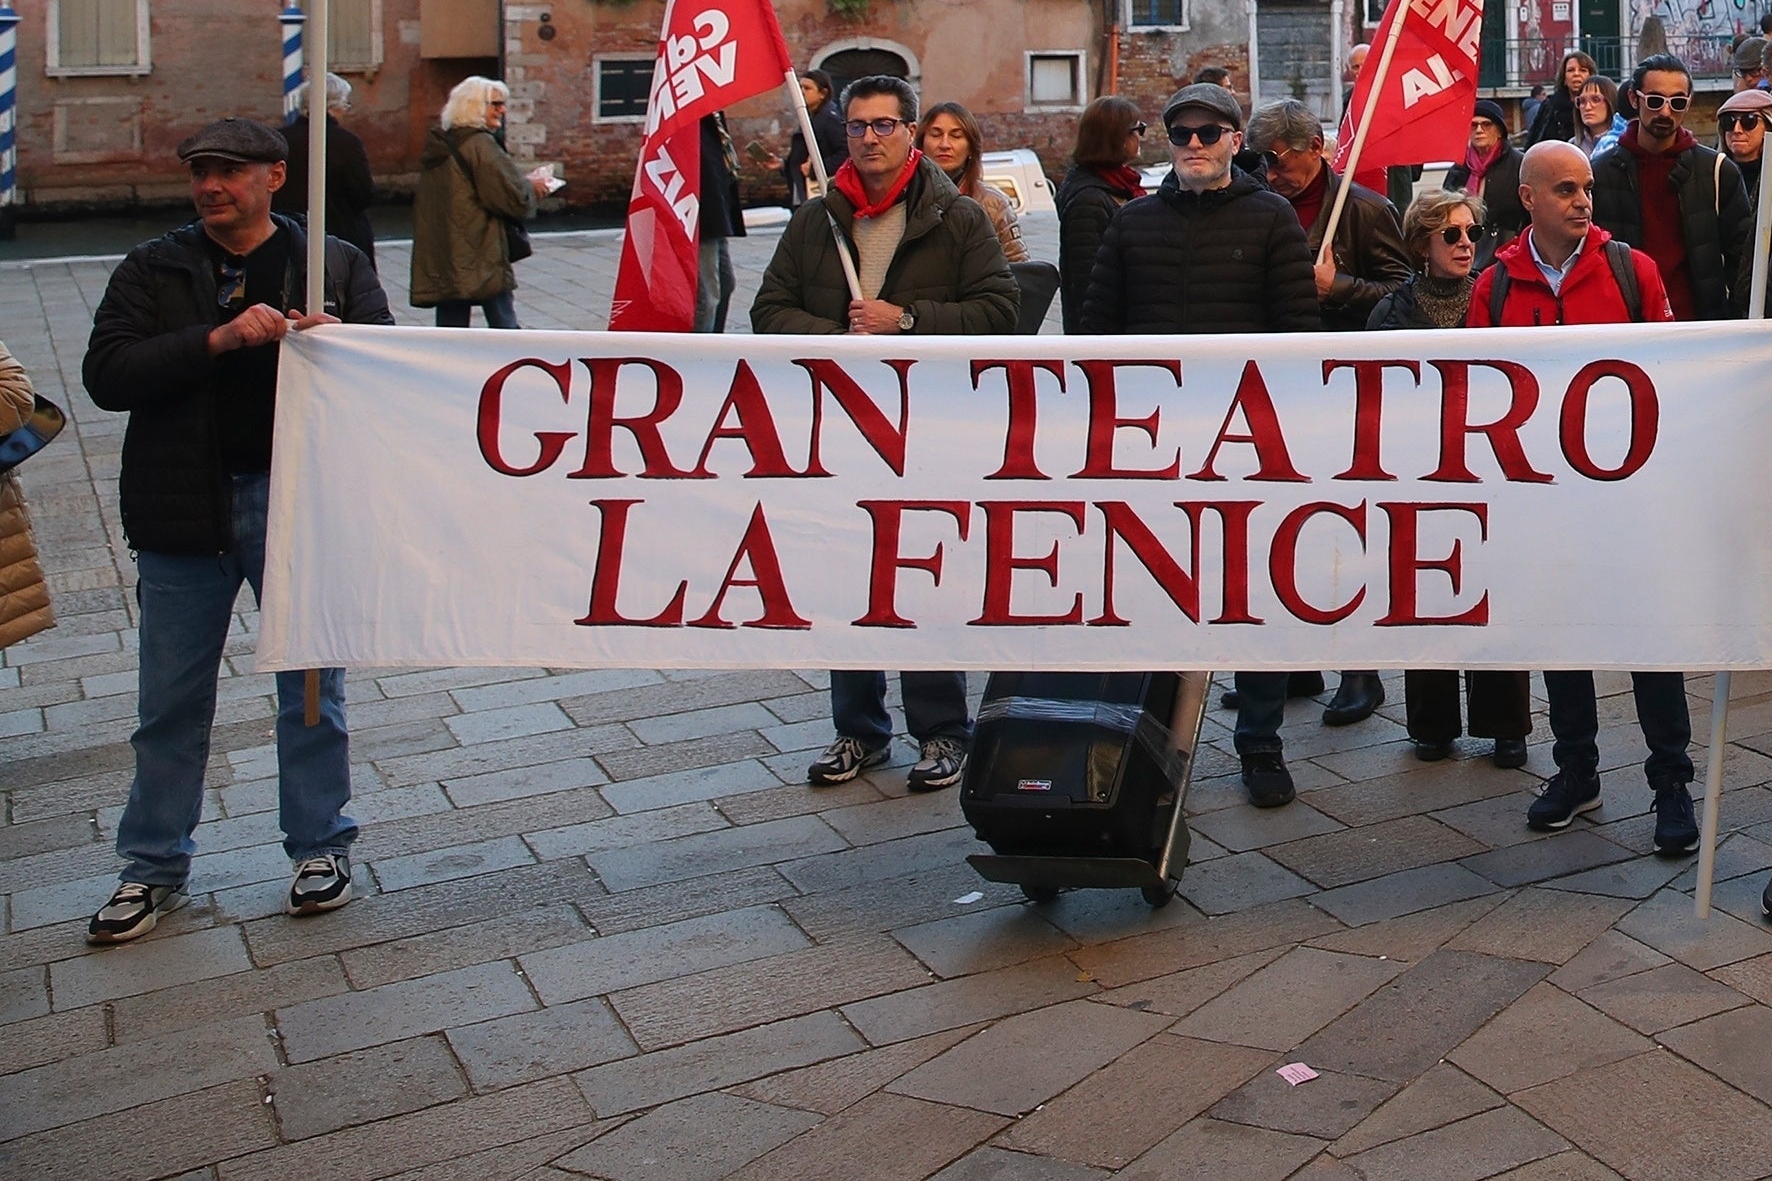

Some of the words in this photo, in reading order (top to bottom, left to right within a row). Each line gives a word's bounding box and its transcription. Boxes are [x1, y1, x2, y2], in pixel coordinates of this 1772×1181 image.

[476, 357, 914, 480] GRAN
[970, 358, 1659, 483] TEATRO
[574, 498, 812, 630] LA
[851, 499, 1490, 629] FENICE
